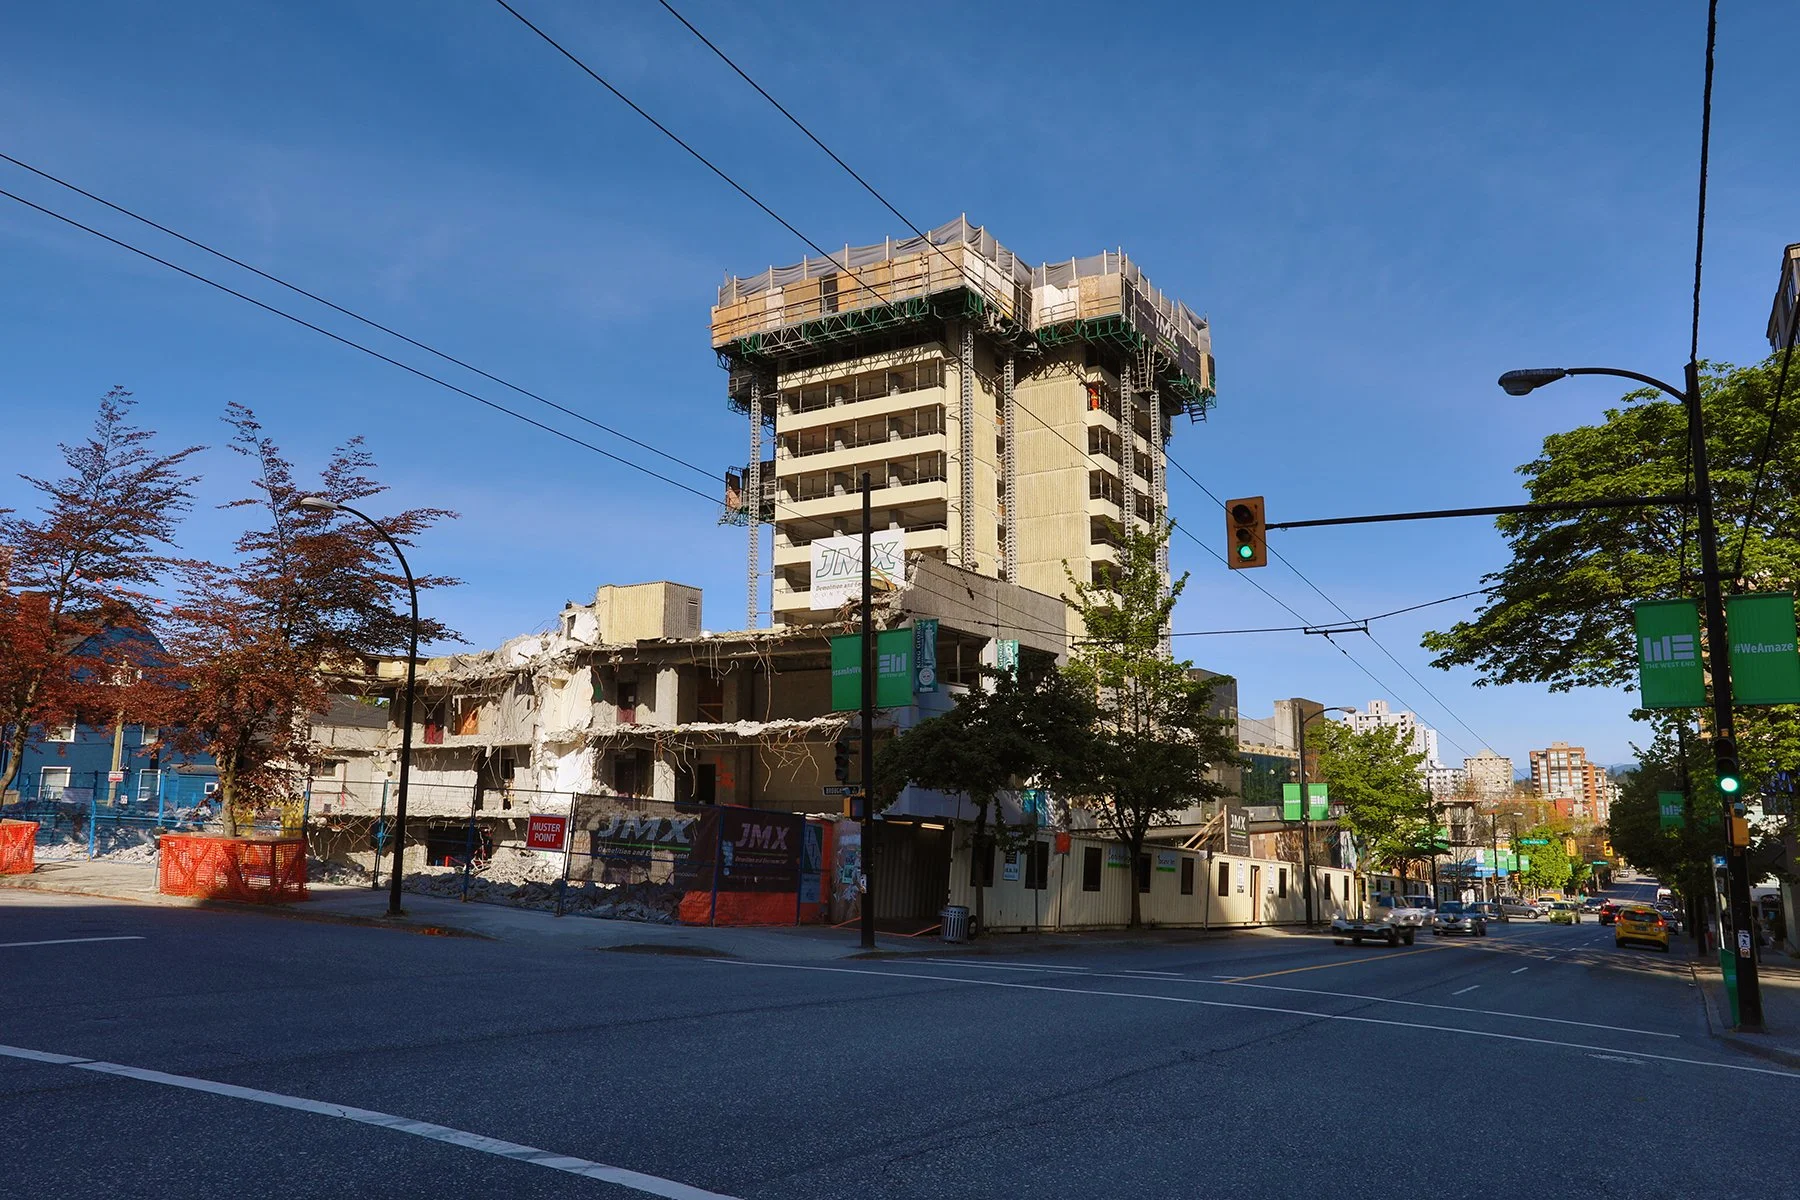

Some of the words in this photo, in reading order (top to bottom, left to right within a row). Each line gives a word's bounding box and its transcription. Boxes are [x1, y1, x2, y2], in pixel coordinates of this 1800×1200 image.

[816, 541, 899, 578] JMX
[1734, 642, 1794, 654] #WeAmaze
[1660, 661, 1680, 669] WEST
[1680, 660, 1696, 668] END
[532, 822, 561, 833] MUSTER
[597, 813, 696, 844] JMX
[1230, 814, 1246, 831] JMX
[534, 833, 556, 843] POINT
[735, 823, 790, 850] JMX
[632, 848, 645, 857] and
